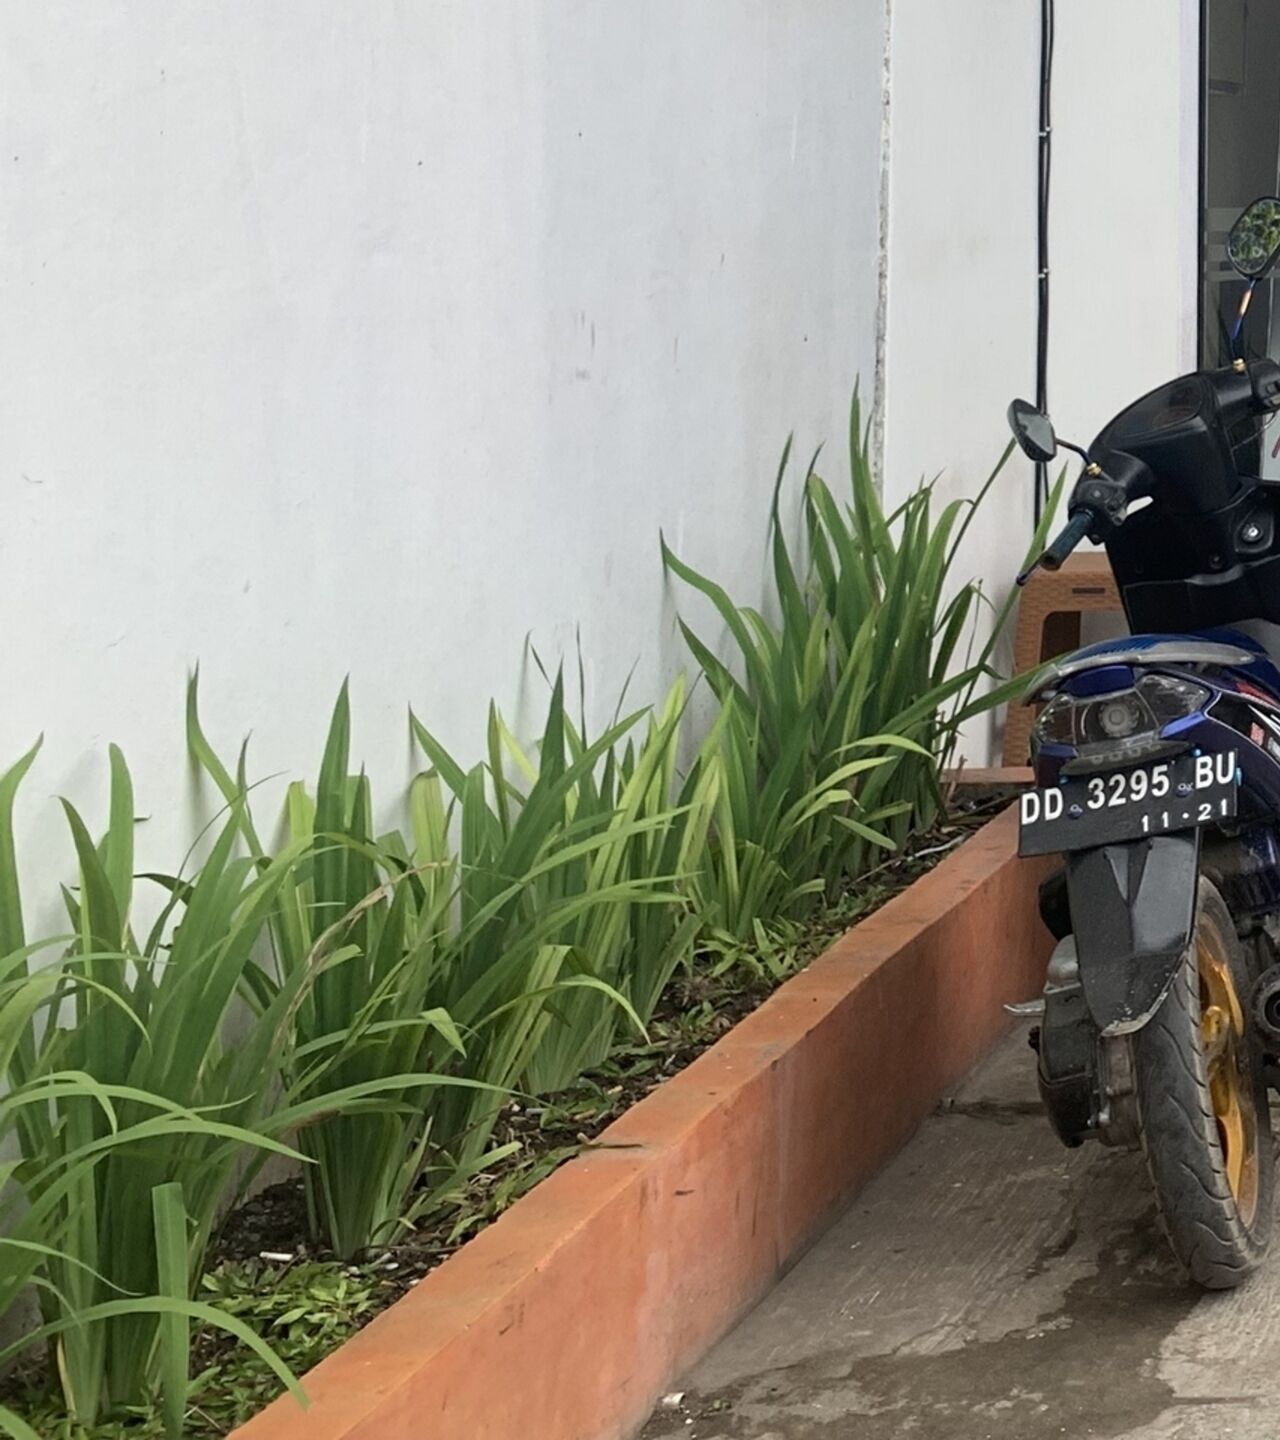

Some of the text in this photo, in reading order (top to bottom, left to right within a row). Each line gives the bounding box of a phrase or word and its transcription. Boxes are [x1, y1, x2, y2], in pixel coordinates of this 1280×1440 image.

[1020, 751, 1236, 826] DD 3295 BU
